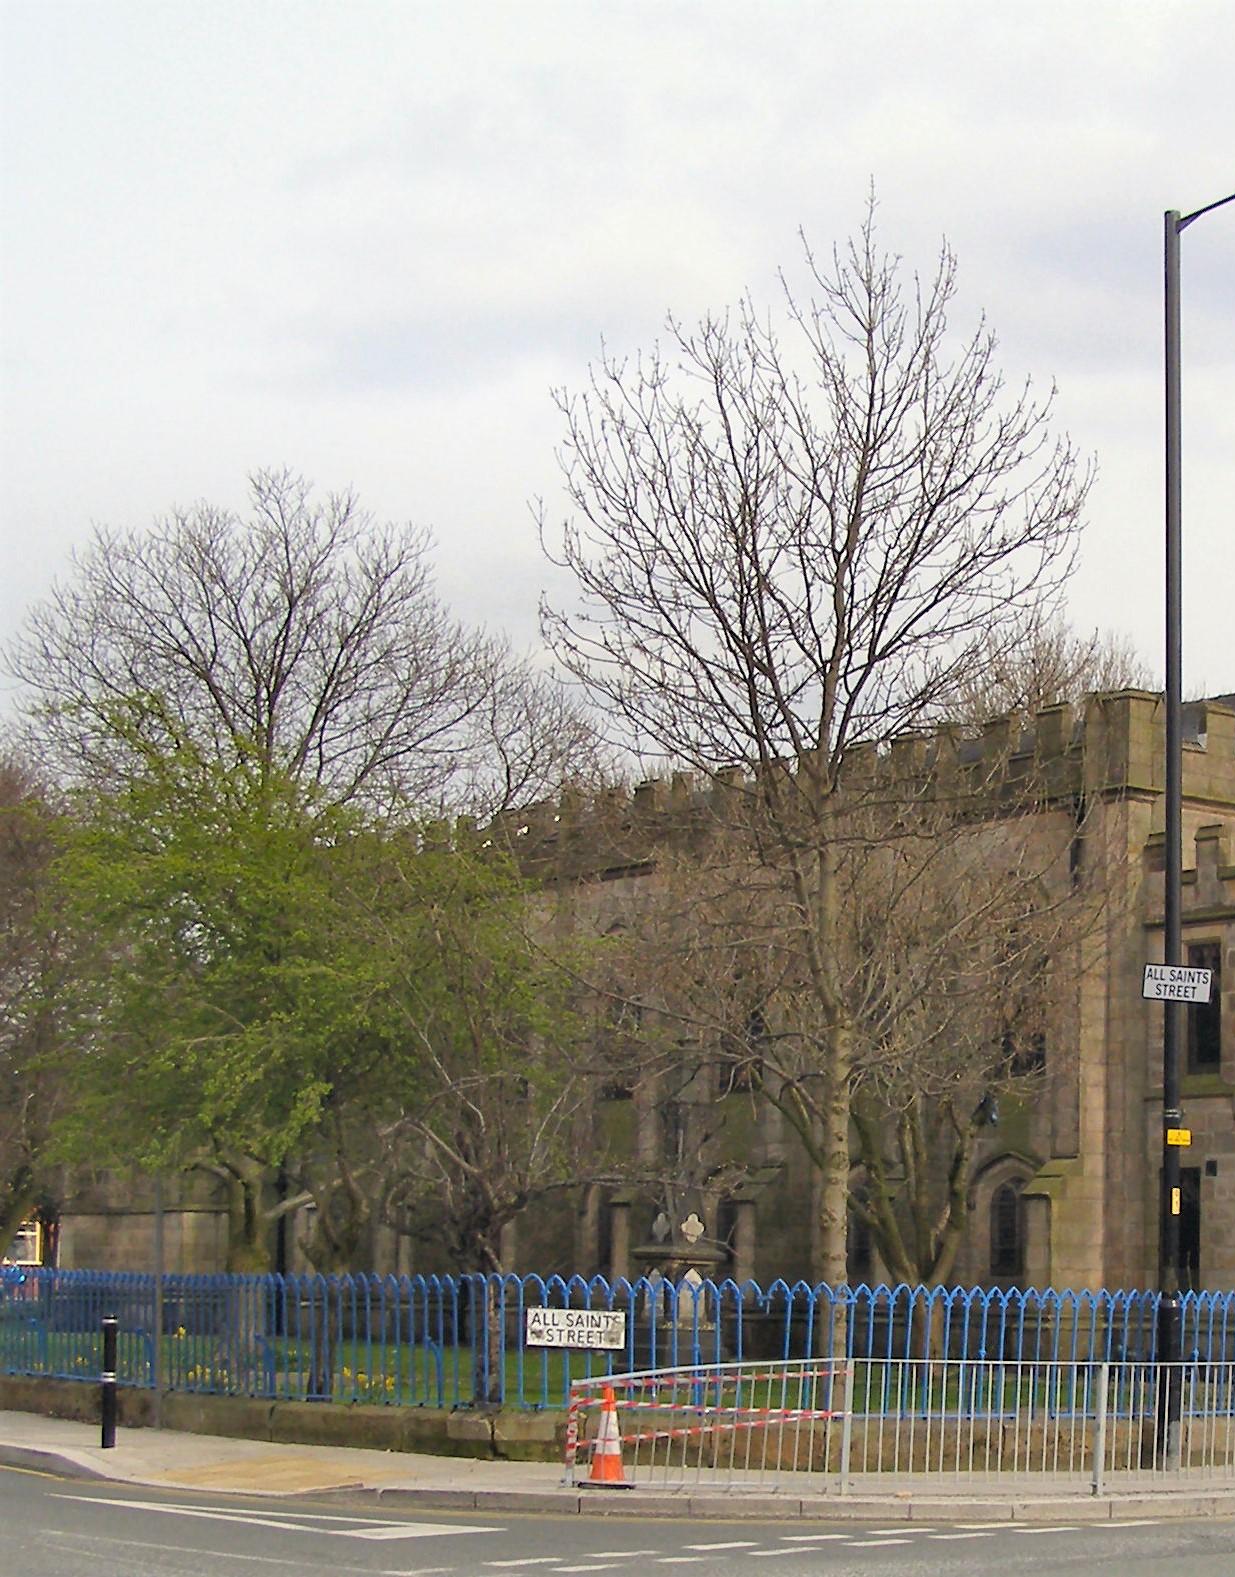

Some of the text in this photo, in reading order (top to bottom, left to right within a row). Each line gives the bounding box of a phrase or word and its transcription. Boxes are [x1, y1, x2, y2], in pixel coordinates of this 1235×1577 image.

[1147, 968, 1209, 984] ALL SAINTS
[1155, 984, 1197, 999] STREET
[531, 1312, 559, 1326] ALL
[546, 1329, 605, 1344] STREET
